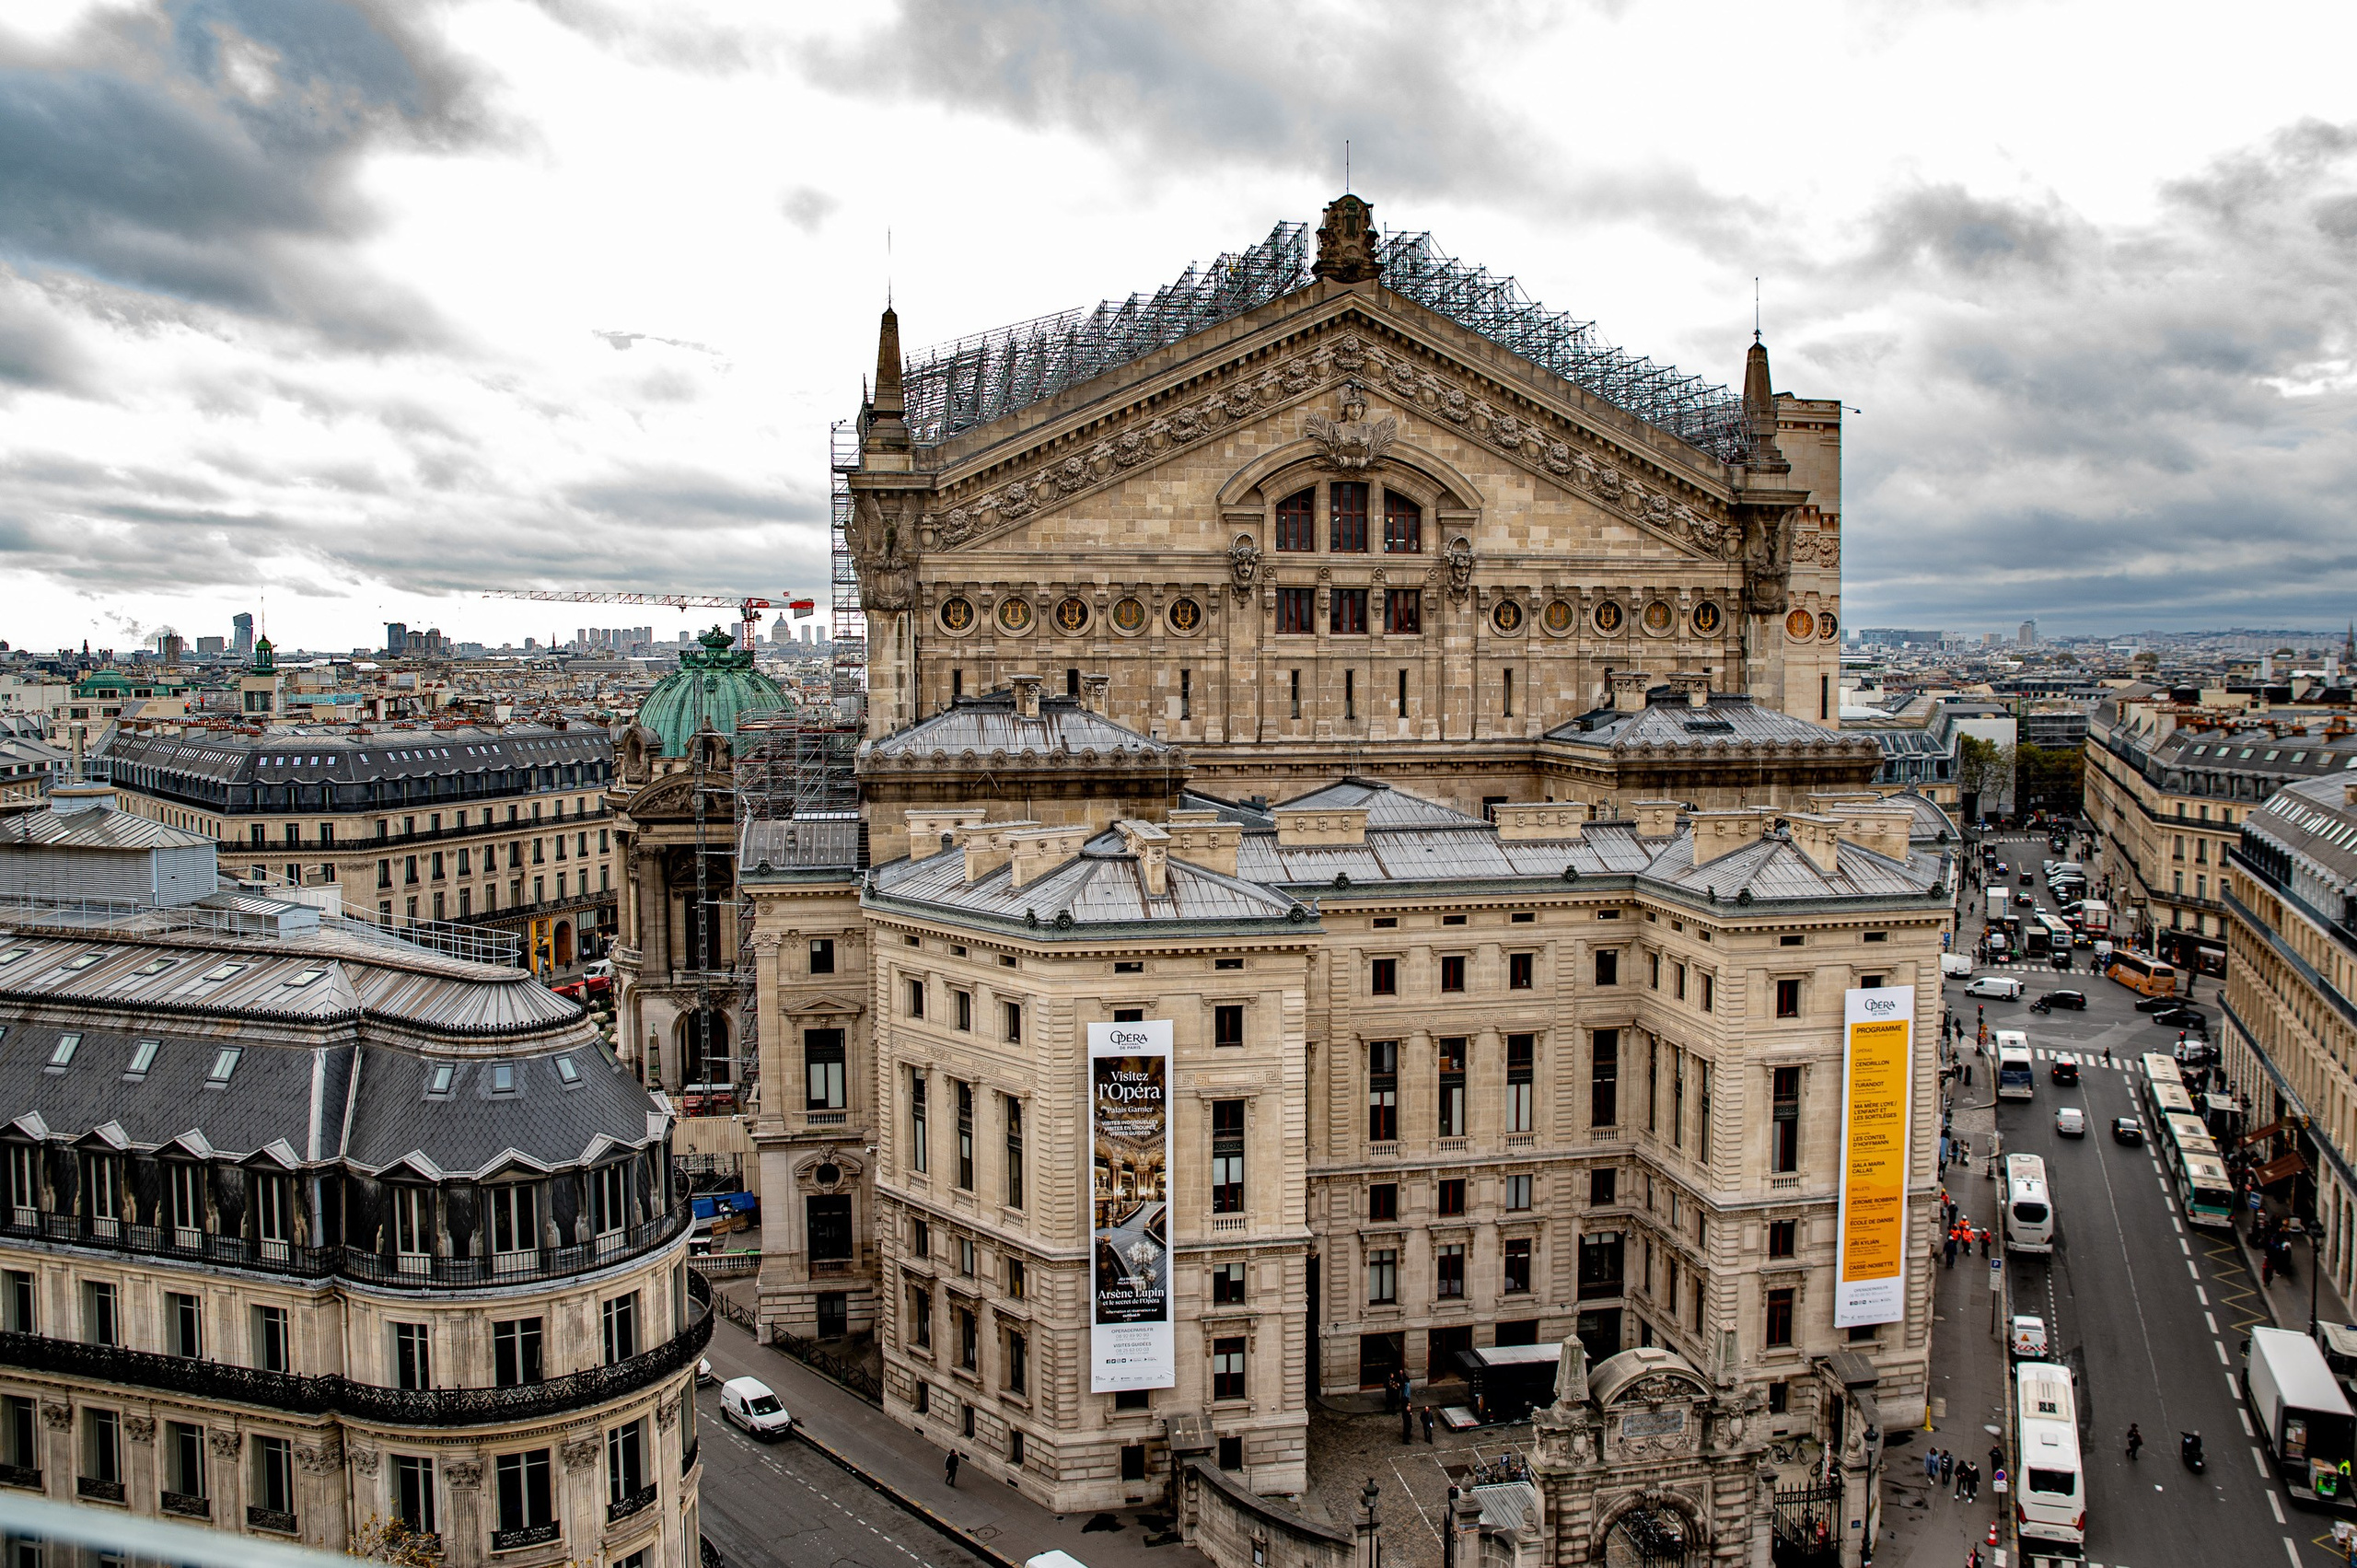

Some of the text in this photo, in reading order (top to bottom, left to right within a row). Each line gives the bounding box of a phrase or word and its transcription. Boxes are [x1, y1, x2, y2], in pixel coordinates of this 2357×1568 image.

[1857, 1025, 1902, 1034] PROGRAMME
[1110, 1030, 1148, 1045] OPÉRA
[1111, 1071, 1149, 1081] Visitez
[1849, 1261, 1894, 1270] CASSE-NOISETTE
[1098, 1288, 1164, 1299] Arsène Lupin
